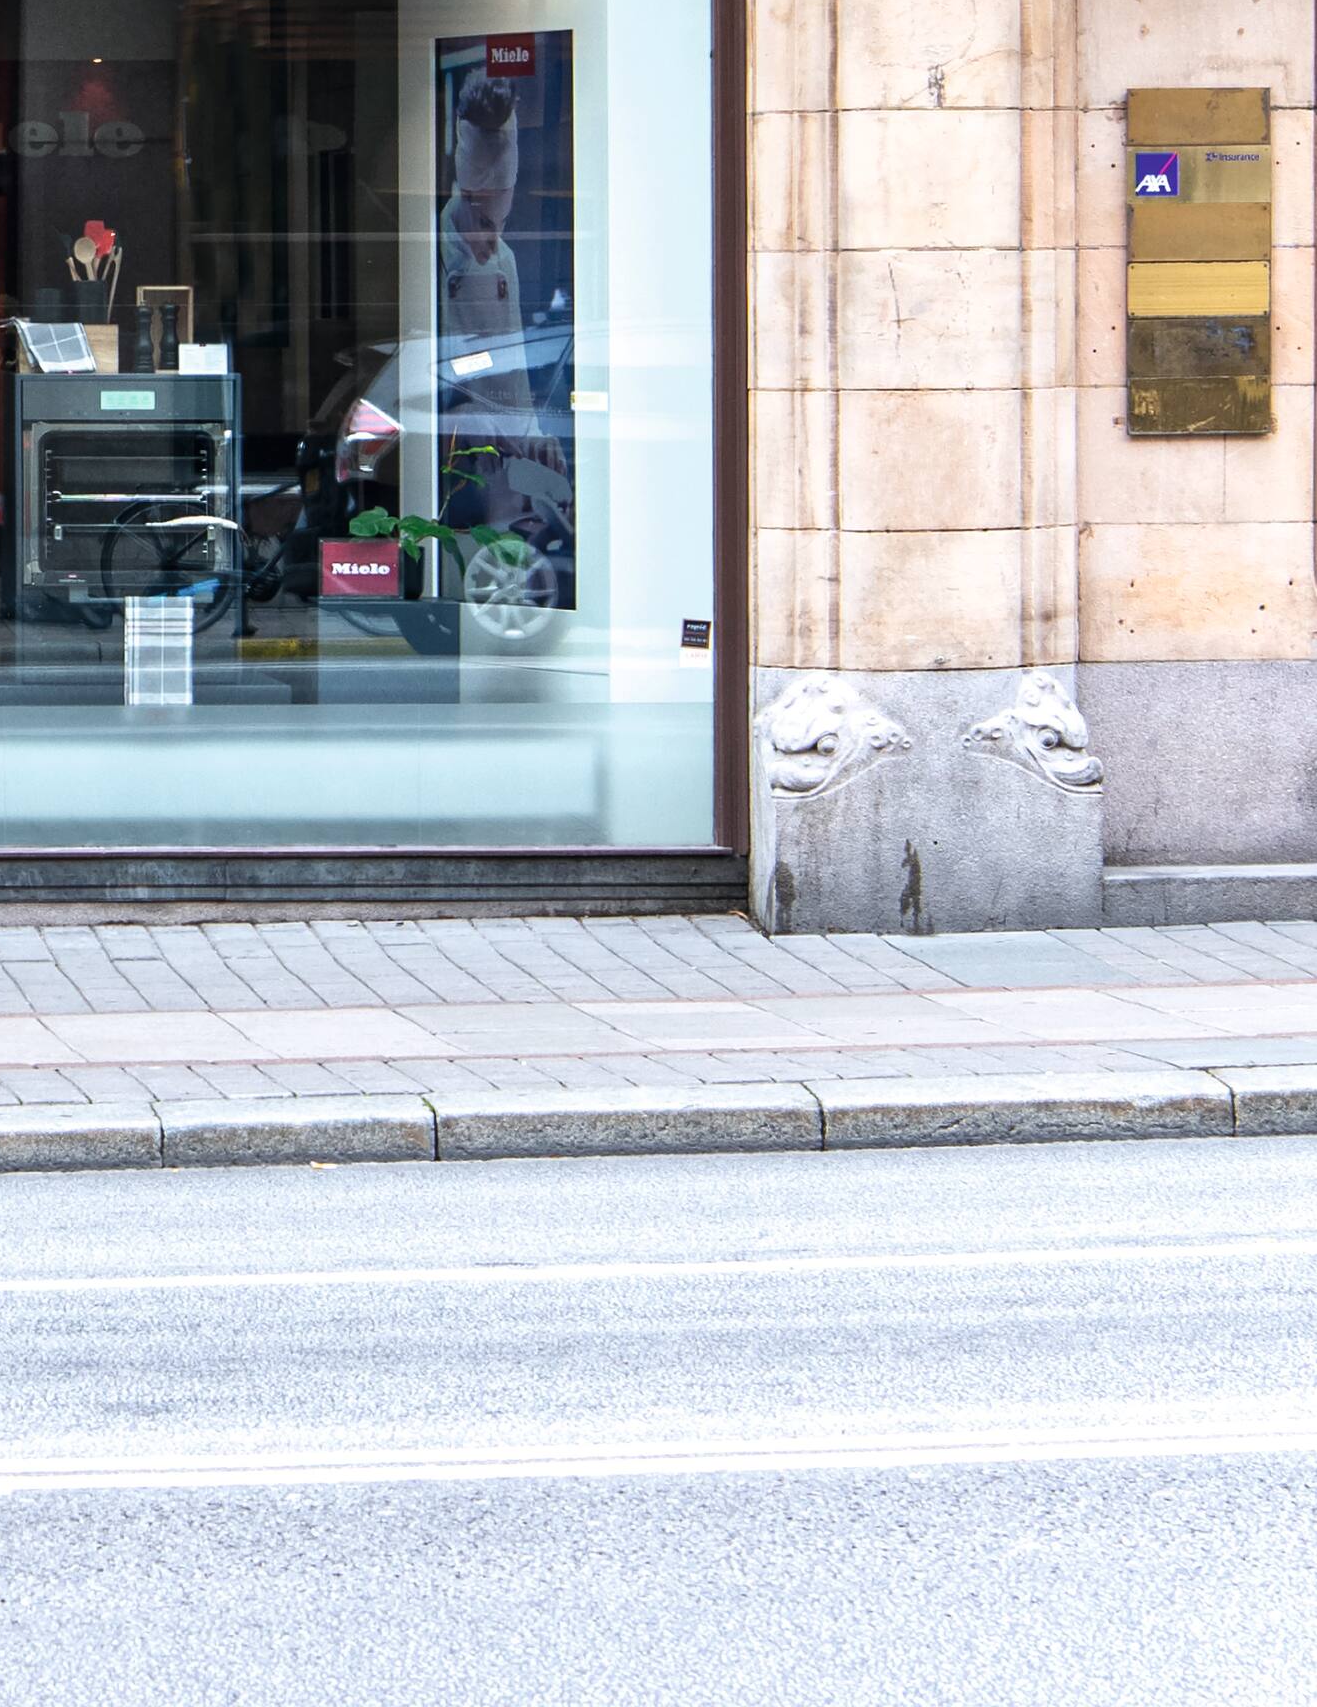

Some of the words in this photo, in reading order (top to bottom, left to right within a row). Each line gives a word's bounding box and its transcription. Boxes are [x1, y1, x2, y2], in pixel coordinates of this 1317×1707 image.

[490, 47, 530, 64] Miele
[1219, 152, 1260, 162] Insurance
[1135, 175, 1172, 192] AXA
[331, 562, 391, 575] Miele
